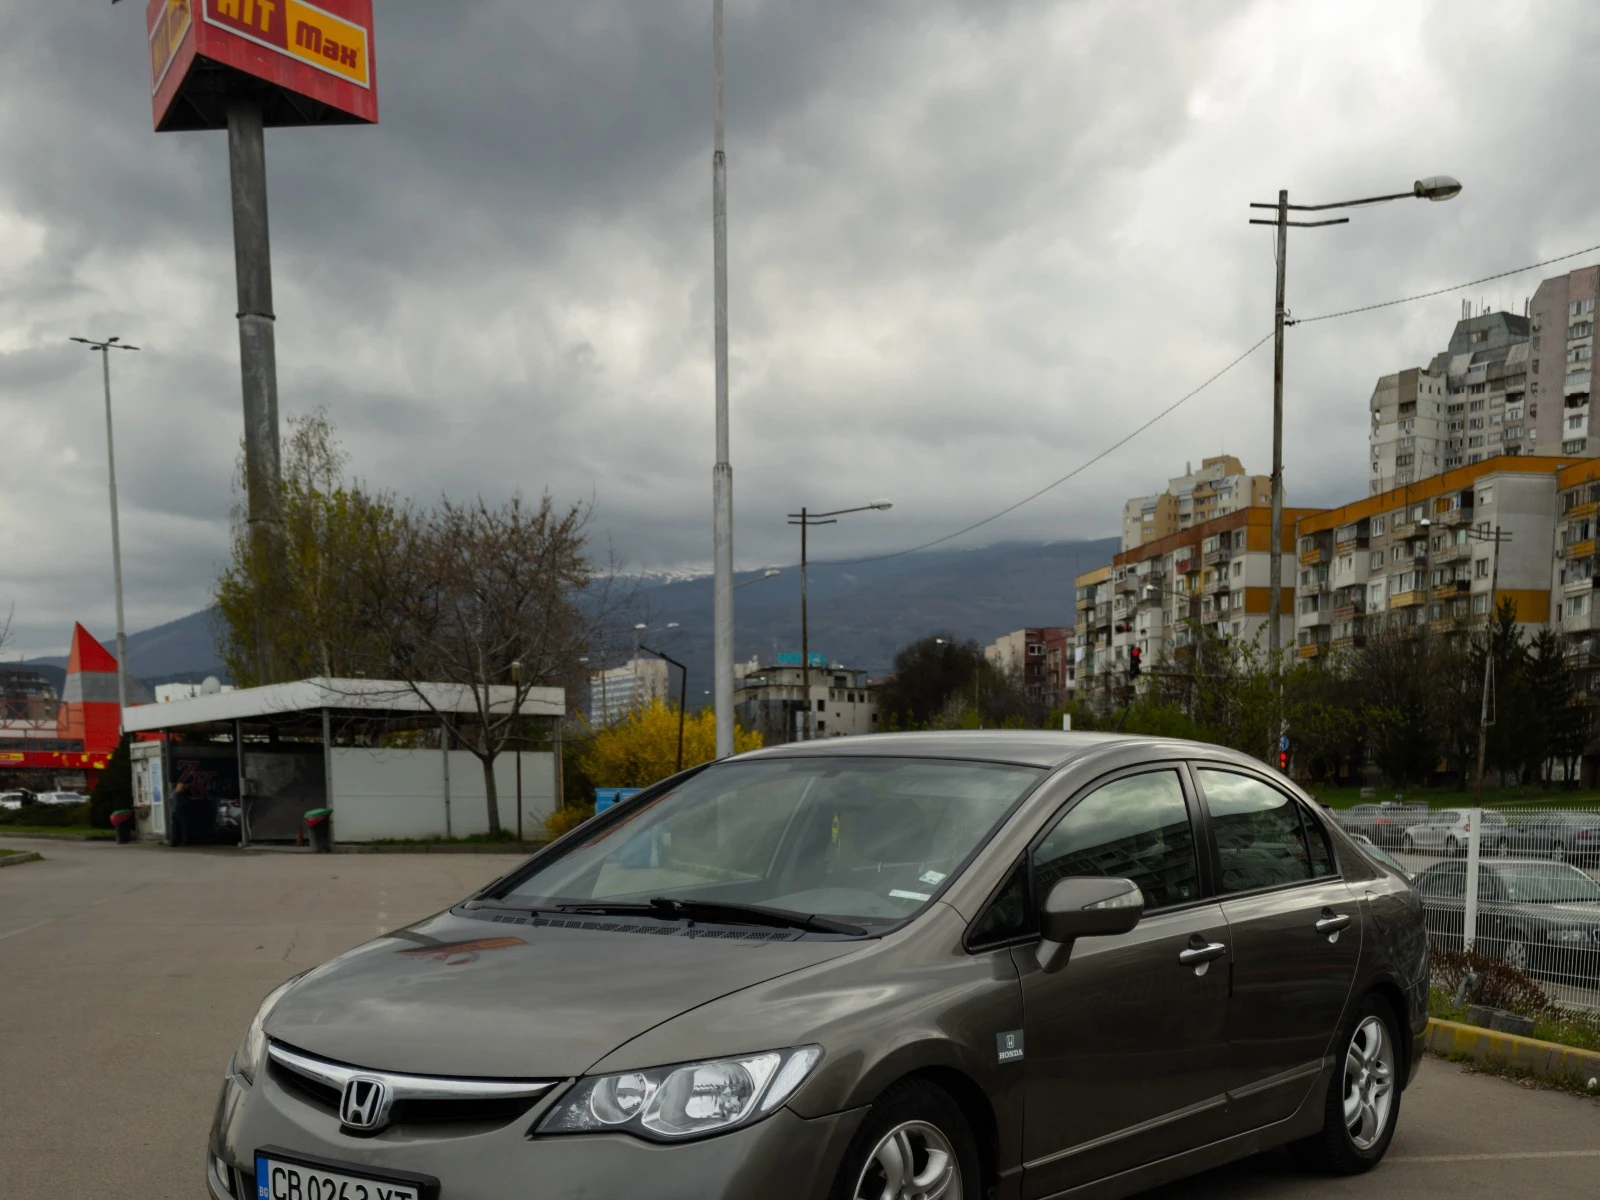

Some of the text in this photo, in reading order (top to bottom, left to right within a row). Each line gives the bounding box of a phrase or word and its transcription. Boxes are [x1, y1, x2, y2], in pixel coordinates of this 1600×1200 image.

[777, 652, 827, 664] HOEL
[999, 1049, 1023, 1059] HONDA
[259, 1186, 269, 1198] BG
